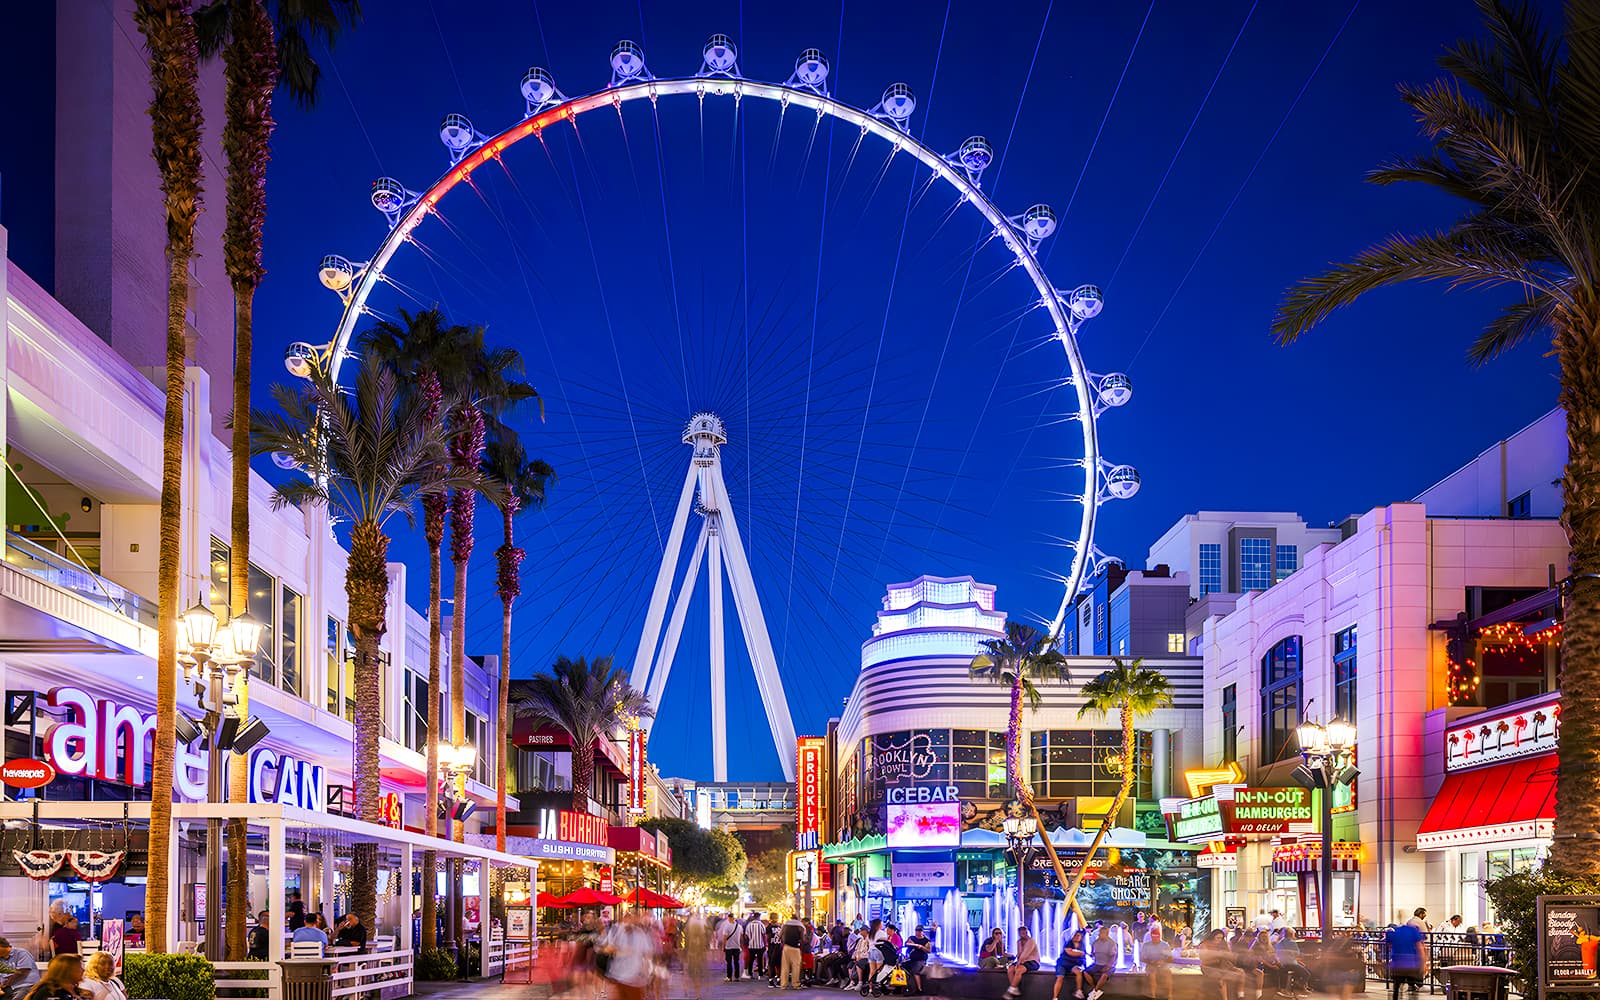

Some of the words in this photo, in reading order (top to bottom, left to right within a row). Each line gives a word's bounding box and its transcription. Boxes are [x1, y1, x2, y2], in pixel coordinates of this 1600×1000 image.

[528, 735, 555, 744] PASTRIES
[805, 751, 816, 832] BROOKLY
[886, 786, 960, 804] ICEBAR
[1235, 791, 1304, 804] IN-N-OUT
[1235, 806, 1311, 819] HAMBURGERS
[538, 808, 557, 840] JA
[560, 810, 608, 847] BURRITOS
[1255, 823, 1282, 831] DELAY
[543, 844, 573, 855] SUSHI
[575, 847, 607, 859] BURRITOS
[1114, 875, 1128, 886] THE
[1548, 910, 1577, 921] Sunday
[1548, 919, 1575, 931] Bloody
